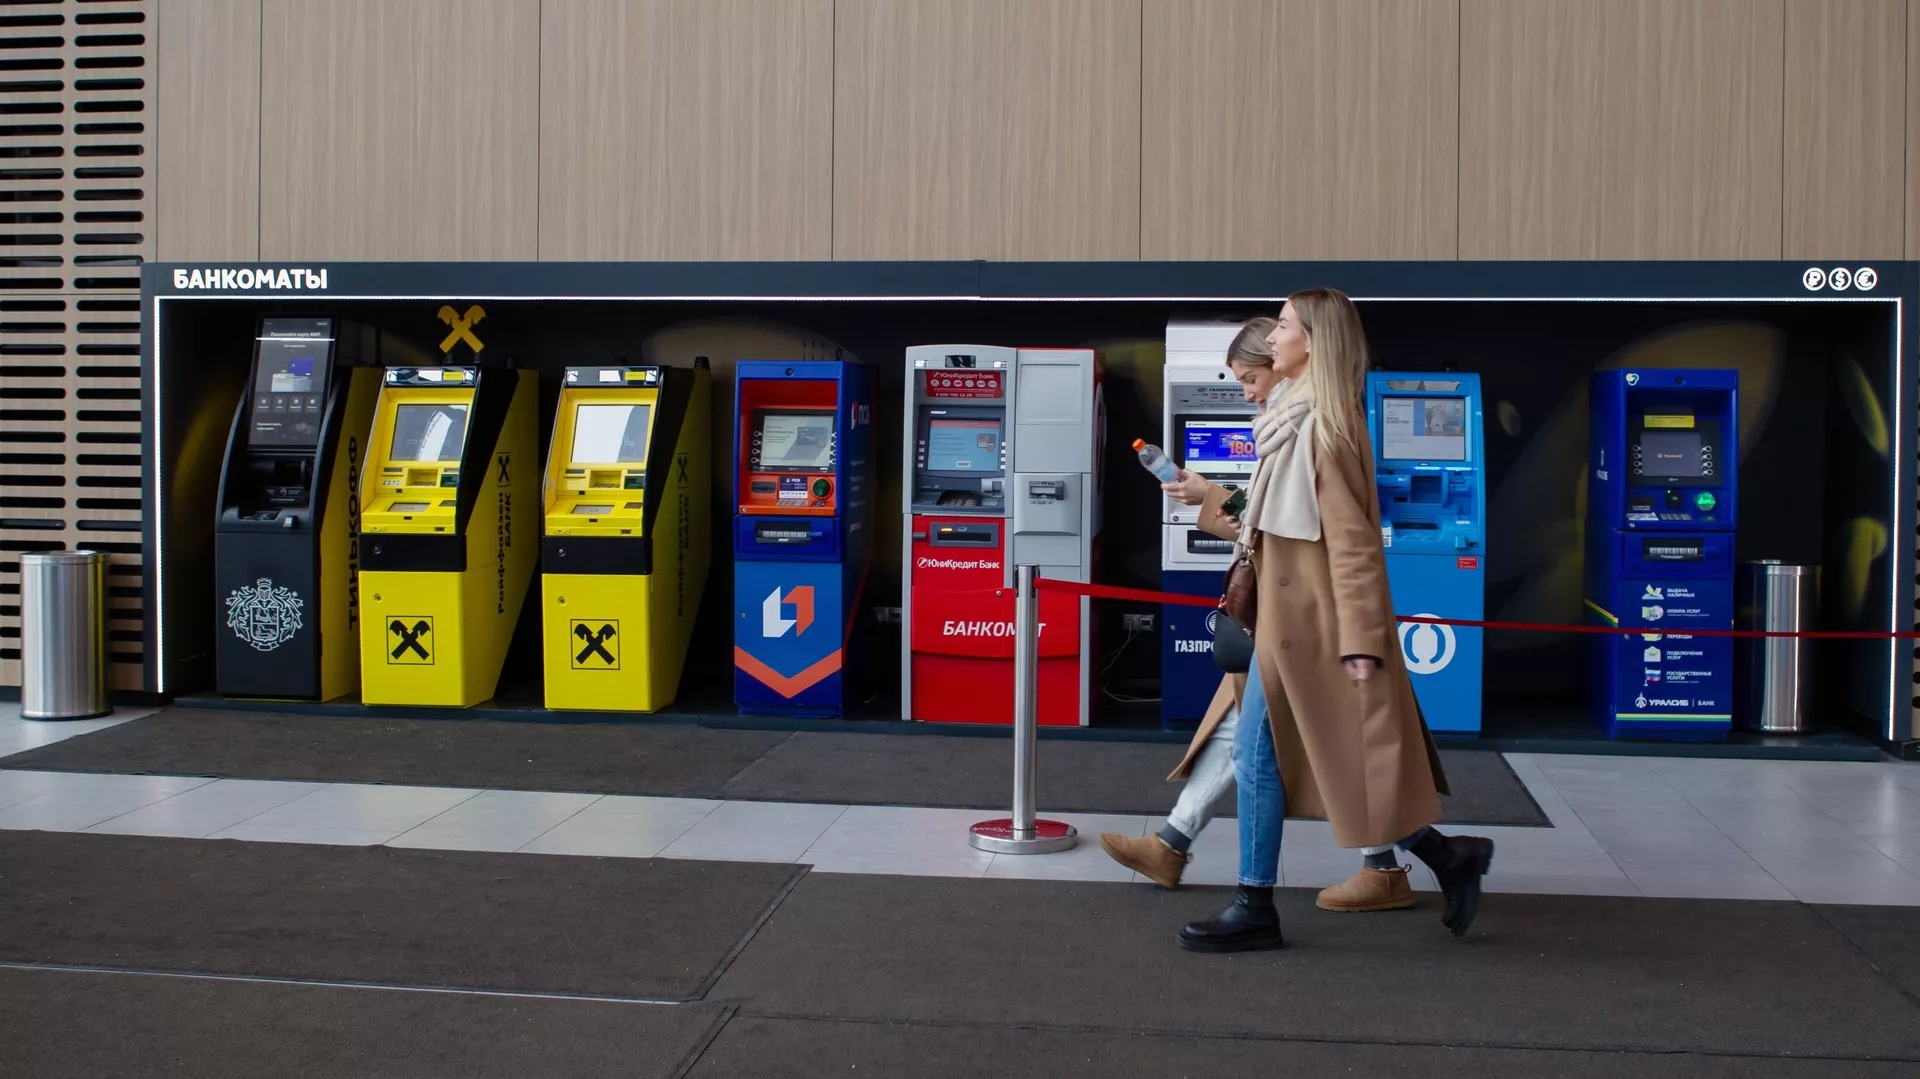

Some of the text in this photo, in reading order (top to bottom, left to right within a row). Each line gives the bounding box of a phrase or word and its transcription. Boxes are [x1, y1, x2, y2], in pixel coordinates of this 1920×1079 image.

[173, 268, 328, 290] БАНКОМАТЫ
[859, 404, 870, 425] ПСБ
[1229, 441, 1254, 454] 180
[349, 436, 358, 630] ТИНЬКОФФ
[497, 492, 505, 614] Райффайзен
[928, 559, 1000, 570] ЮниКредит Банк
[943, 620, 1046, 638] БАНКОМТ
[1175, 640, 1214, 653] ГАЗПР
[1649, 699, 1689, 707] УРАЛСИБ
